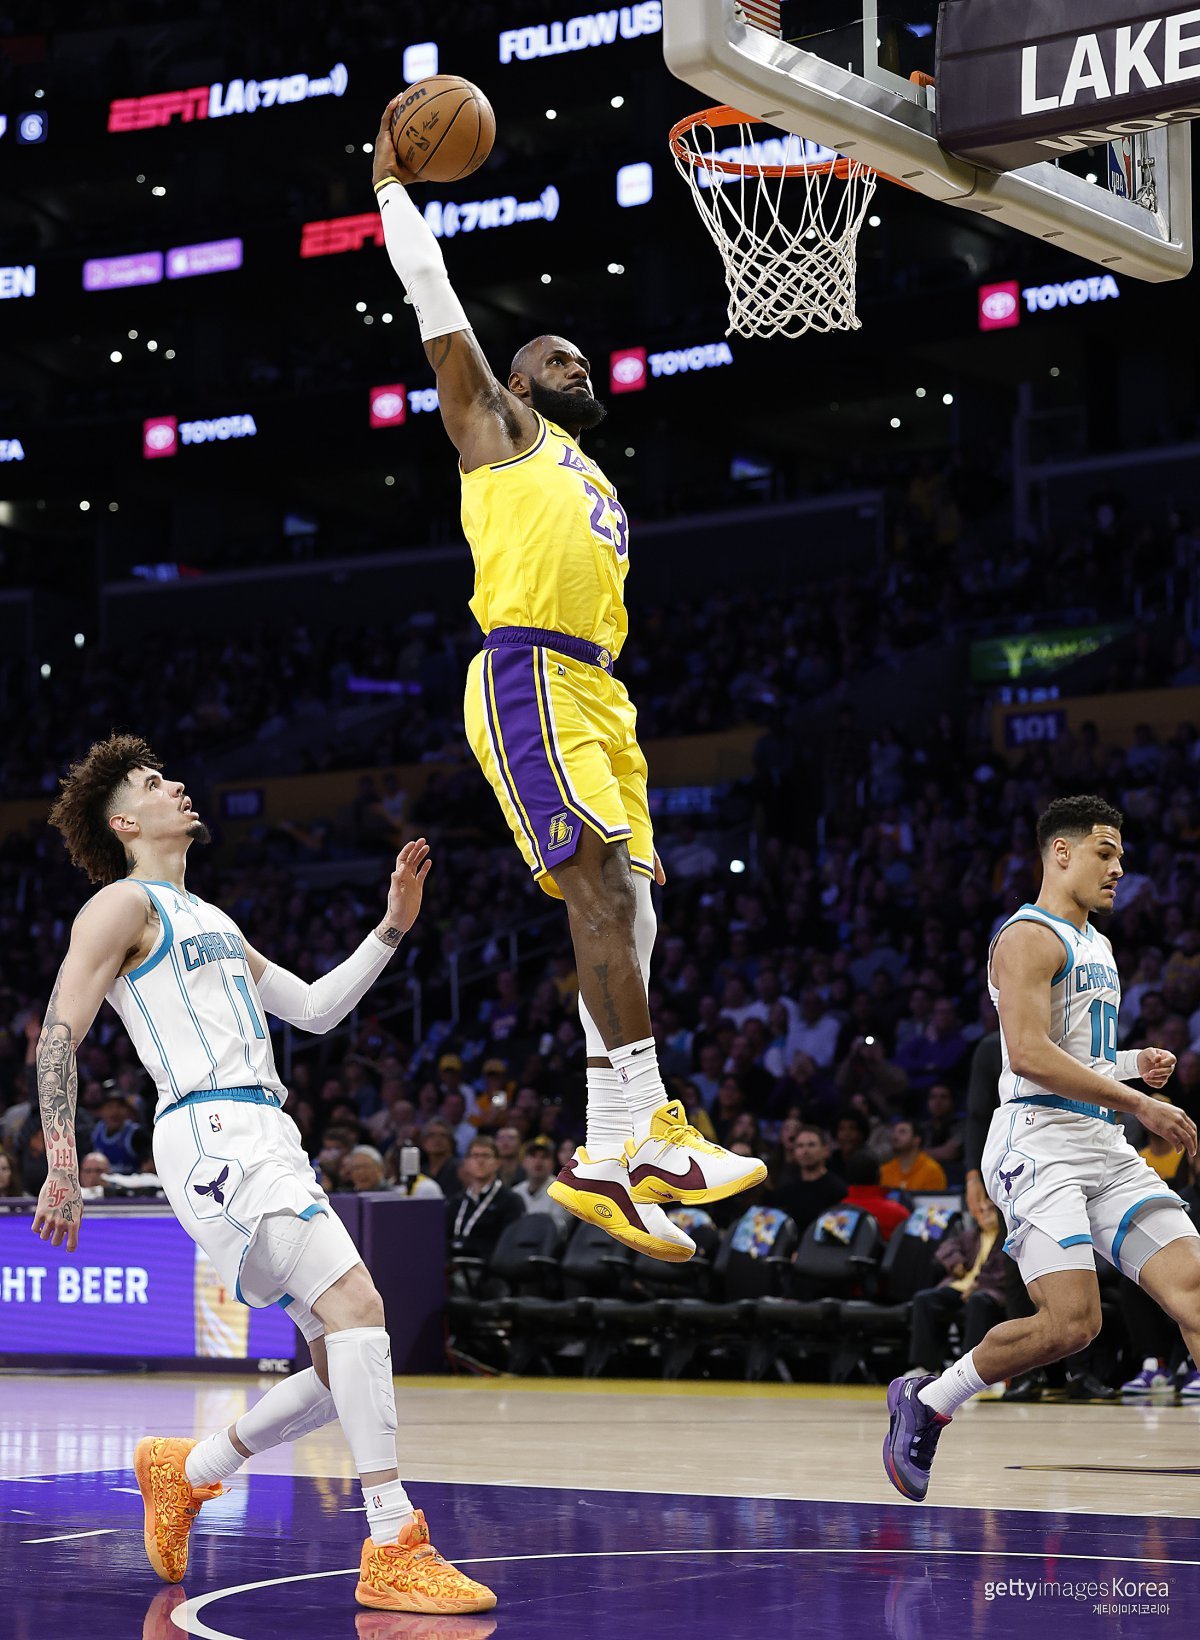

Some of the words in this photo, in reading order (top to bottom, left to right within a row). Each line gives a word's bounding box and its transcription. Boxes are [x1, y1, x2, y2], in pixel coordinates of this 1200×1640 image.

[500, 11, 619, 64] FOLLOW
[620, 1, 662, 39] US
[1022, 274, 1120, 313] TOYOTA
[648, 342, 734, 378] TOYOTA
[178, 414, 257, 445] TOYOTA
[583, 479, 629, 556] 23
[1012, 714, 1057, 744] 101
[231, 974, 266, 1040] 1
[1088, 998, 1118, 1066] 10
[0, 1266, 47, 1303] HT
[58, 1266, 149, 1304] BEER
